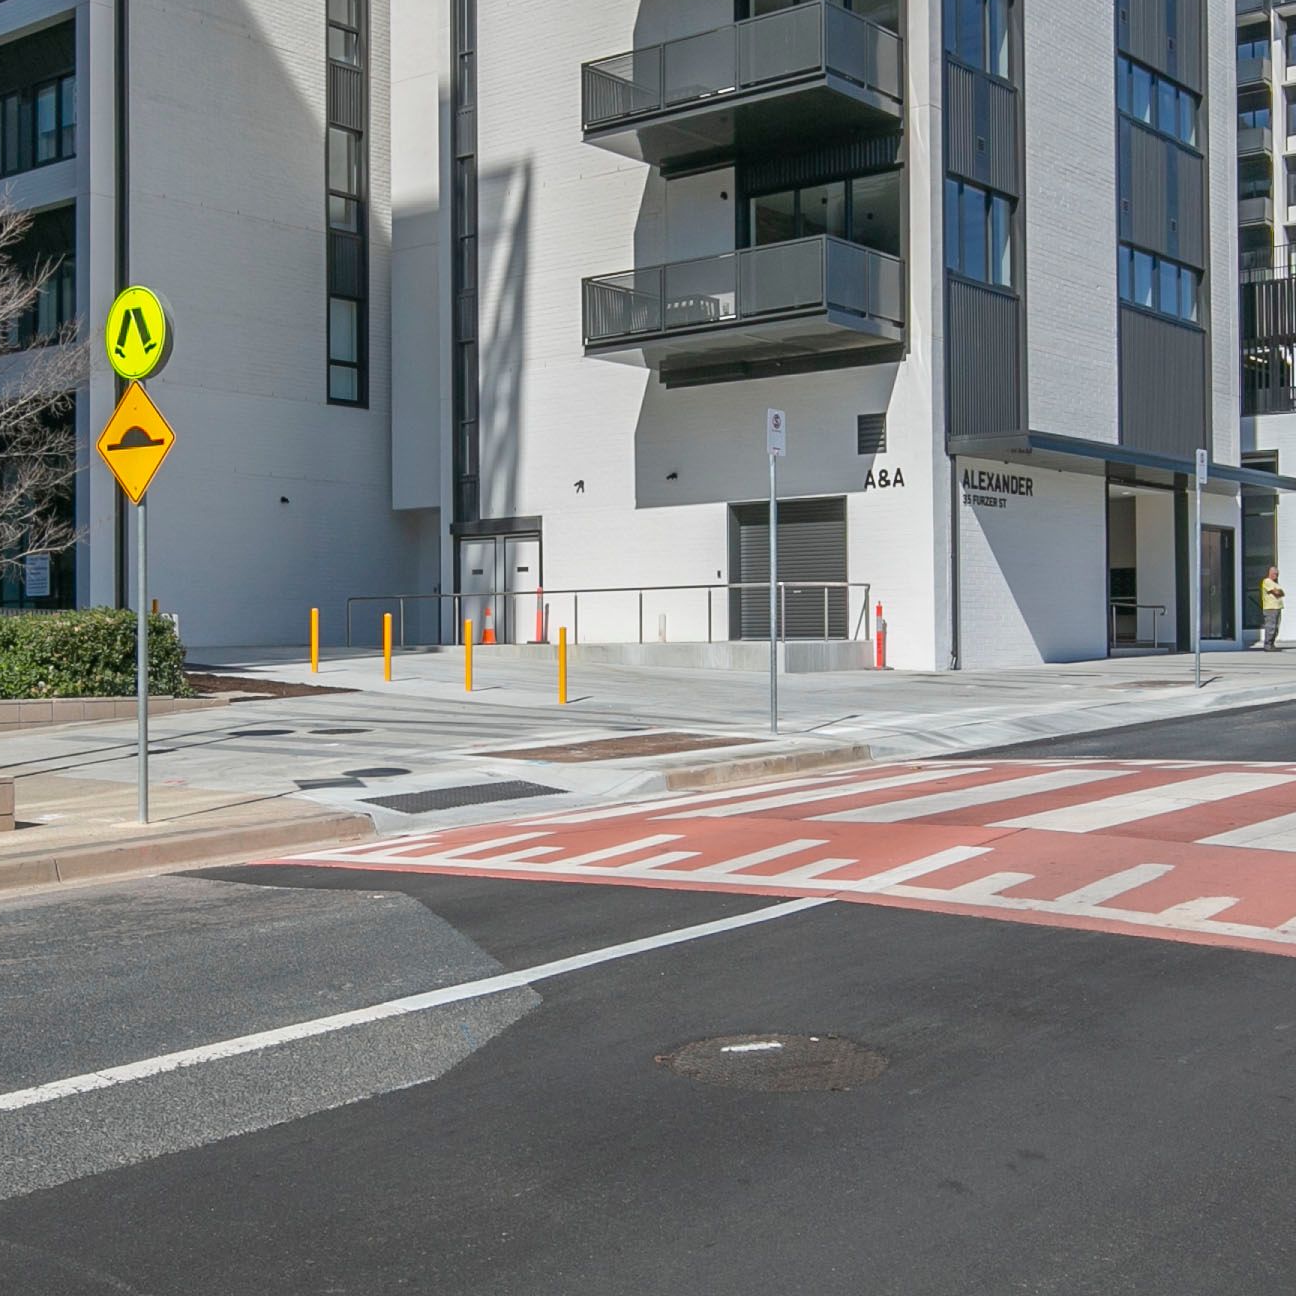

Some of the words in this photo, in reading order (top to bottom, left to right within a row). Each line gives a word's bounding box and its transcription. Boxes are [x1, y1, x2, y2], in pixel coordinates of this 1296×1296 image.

[863, 467, 905, 489] A&A
[962, 468, 1033, 497] ALEXANDER
[962, 494, 972, 505] 35
[972, 495, 998, 508] FURZER
[998, 498, 1007, 508] ST
